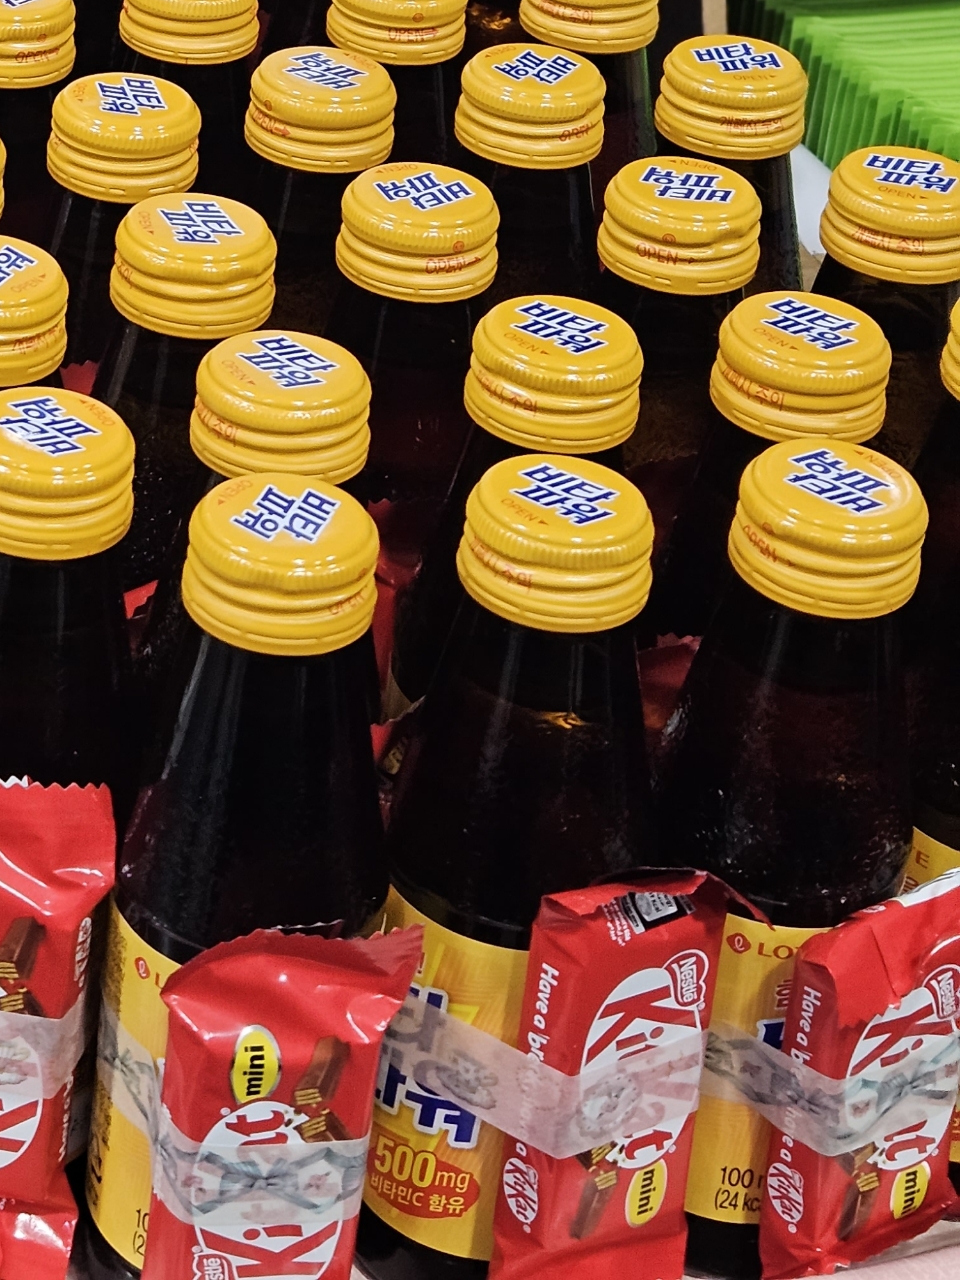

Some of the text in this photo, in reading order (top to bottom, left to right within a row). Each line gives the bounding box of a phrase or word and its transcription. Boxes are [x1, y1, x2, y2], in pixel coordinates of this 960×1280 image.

[291, 52, 371, 78] 파워
[492, 50, 546, 81] 파워
[531, 54, 581, 85] 비타
[692, 43, 754, 62] 비타
[718, 52, 782, 72] 파워
[122, 77, 168, 110] 비타
[284, 65, 361, 91] 비타
[97, 81, 141, 115] 파워
[640, 167, 722, 187] 파워
[864, 154, 944, 174] 비타
[374, 172, 442, 201] 파워
[411, 181, 476, 211] 비타
[657, 185, 735, 202] 비타
[877, 171, 958, 192] 파워
[158, 209, 220, 244] 파워
[183, 202, 244, 236] 비타
[516, 299, 608, 331] 비타
[767, 298, 857, 331] 비타
[511, 320, 609, 353] 파워
[760, 317, 858, 352] 파워
[237, 353, 326, 388] 파워
[253, 336, 339, 371] 비타
[8, 397, 101, 439] 파워
[517, 463, 620, 501] 비타
[789, 450, 892, 494] 파워
[510, 484, 617, 526] 파워
[784, 474, 888, 514] 비타
[232, 485, 295, 540] 파워
[283, 488, 341, 543] 비타
[535, 963, 559, 1014] Have
[799, 986, 822, 1033] Have
[244, 1045, 265, 1099] mini
[371, 1174, 465, 1214] 비타민C 함유
[636, 1169, 655, 1216] mini
[902, 1170, 921, 1216] mini
